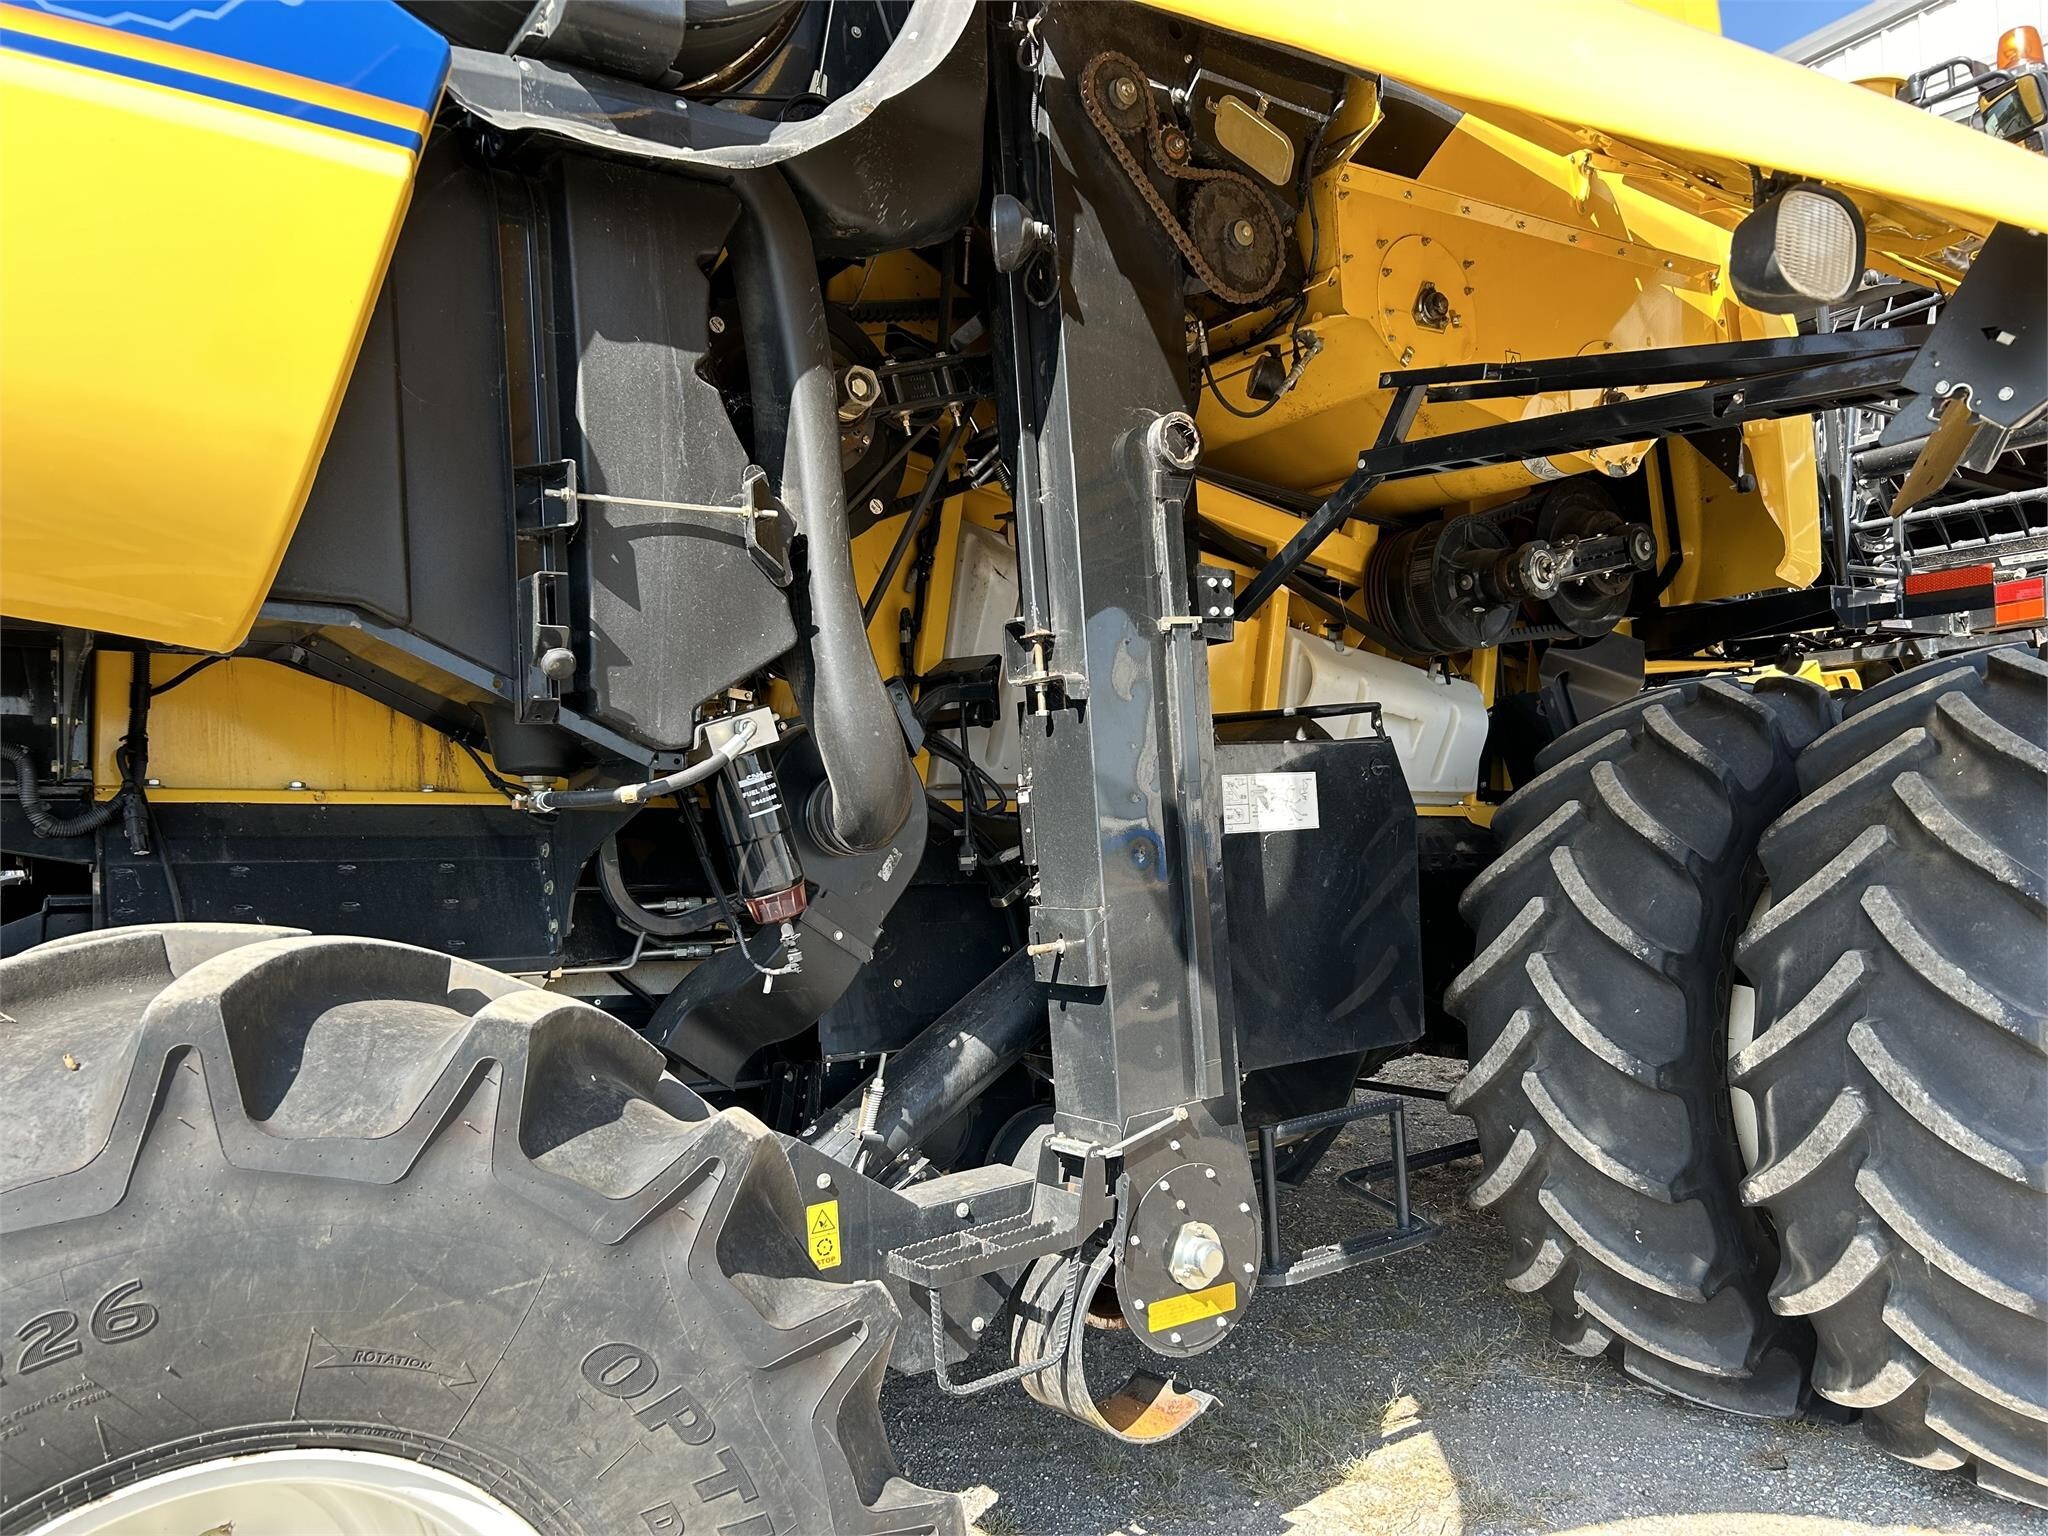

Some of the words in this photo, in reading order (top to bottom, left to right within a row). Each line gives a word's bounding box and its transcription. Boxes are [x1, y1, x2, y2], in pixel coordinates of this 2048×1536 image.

[742, 788, 760, 798] FUEL
[816, 1256, 836, 1265] STOP
[0, 1278, 159, 1388] 26
[352, 1350, 433, 1369] ROTATION
